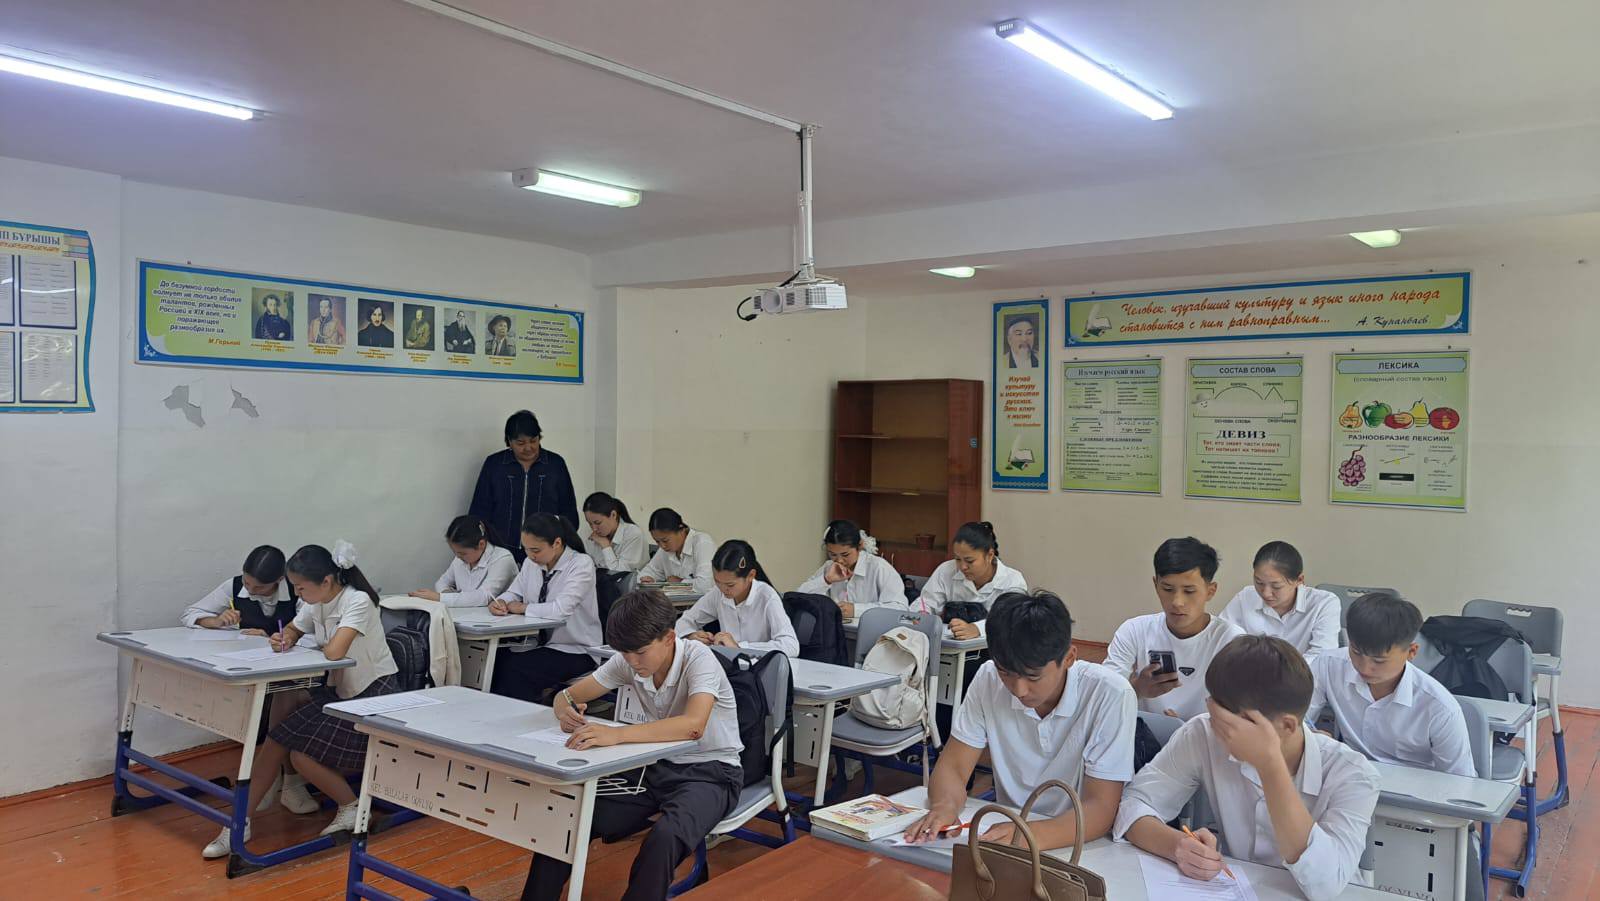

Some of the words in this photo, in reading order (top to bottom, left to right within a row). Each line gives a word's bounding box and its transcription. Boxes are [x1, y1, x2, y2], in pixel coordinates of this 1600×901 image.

[160, 280, 170, 288] До
[171, 282, 202, 291] безумной
[204, 285, 235, 294] гордости
[193, 292, 218, 301] только
[198, 301, 235, 311] рожденных
[1121, 302, 1166, 316] Человек,
[1170, 298, 1230, 317] изучавший
[1234, 296, 1294, 313] культуру
[1299, 297, 1308, 305] и
[1312, 295, 1343, 310] язык
[1348, 294, 1384, 305] иного
[1390, 289, 1441, 305] народа
[160, 305, 186, 314] Россией
[193, 308, 204, 316] XIX
[170, 324, 215, 333] разнообразие
[1119, 318, 1185, 333] становится
[1189, 321, 1195, 329] с
[1199, 320, 1223, 329] ним
[1219, 367, 1249, 375] СОСТАВ
[1250, 366, 1276, 374] СЛОВА
[1377, 362, 1420, 371] ЛЕКСИКА
[1104, 368, 1128, 377] русский
[1422, 375, 1448, 383] языка)
[1216, 430, 1267, 440] ДЕВИЗ
[1347, 434, 1410, 442] РАЗНООБРАЗИЕ
[1412, 435, 1450, 443] ЛЕКСИКИ
